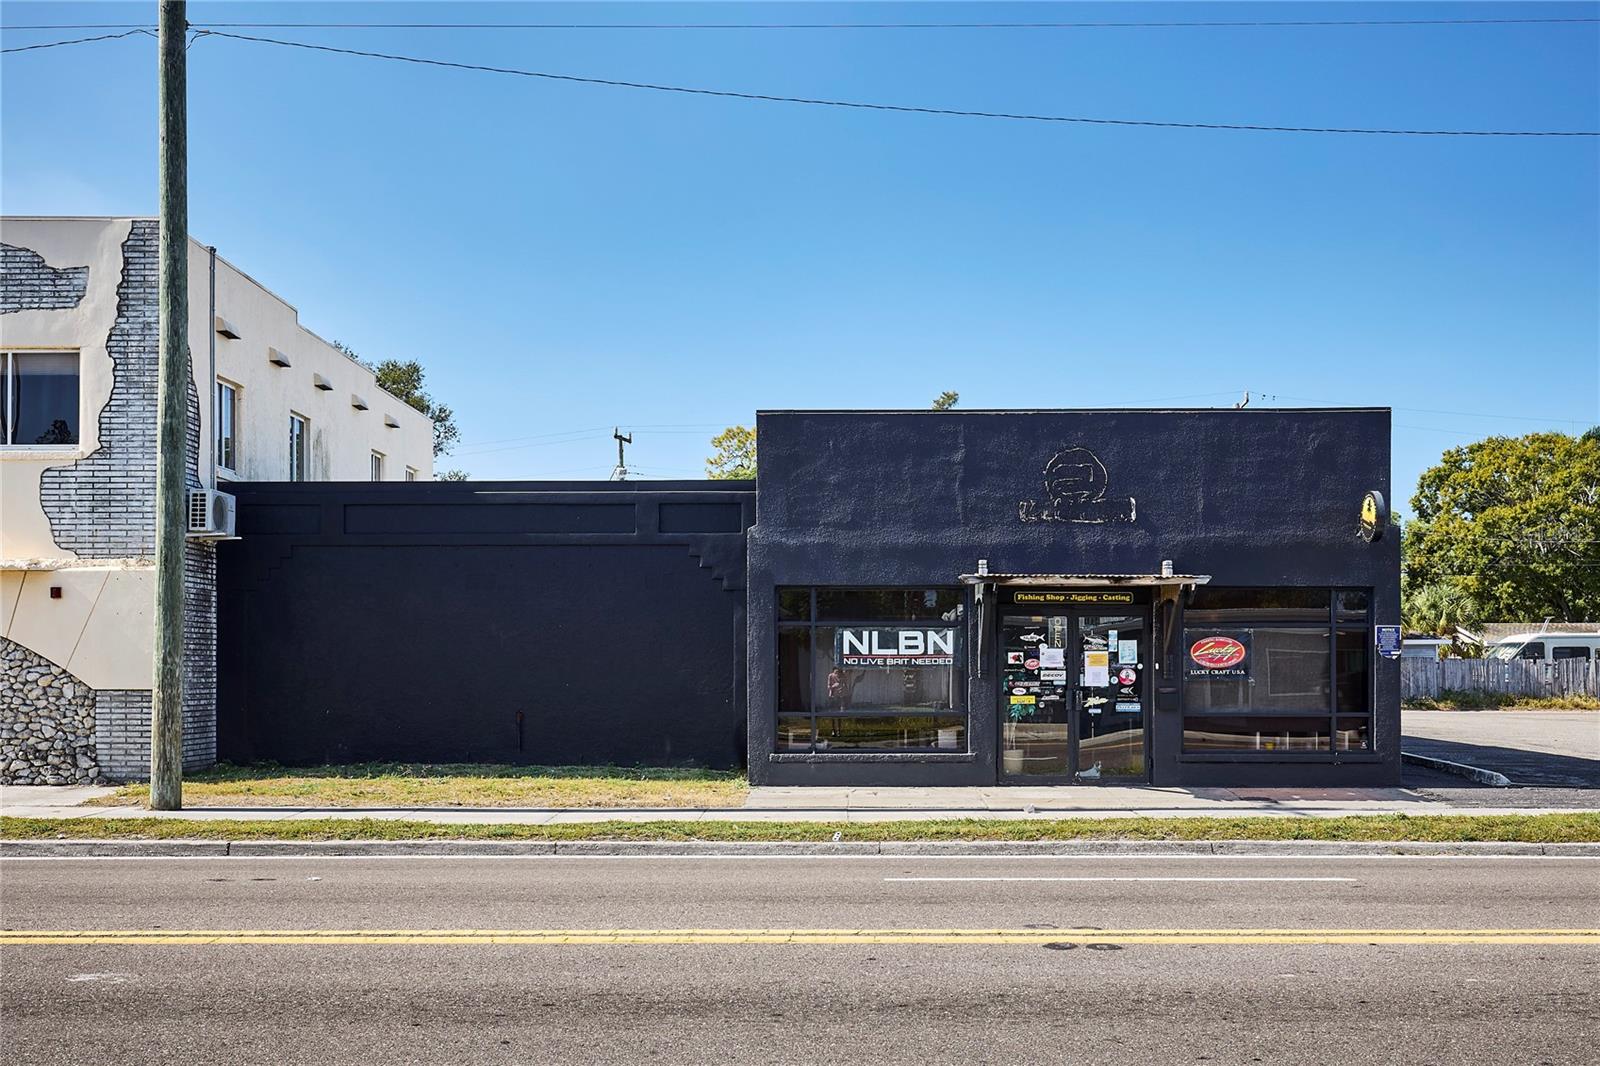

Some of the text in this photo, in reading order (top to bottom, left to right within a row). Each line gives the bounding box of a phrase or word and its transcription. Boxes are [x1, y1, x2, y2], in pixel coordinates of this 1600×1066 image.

[1017, 594, 1130, 602] Fishing Shop Jigging Casting
[843, 630, 954, 655] NLBN
